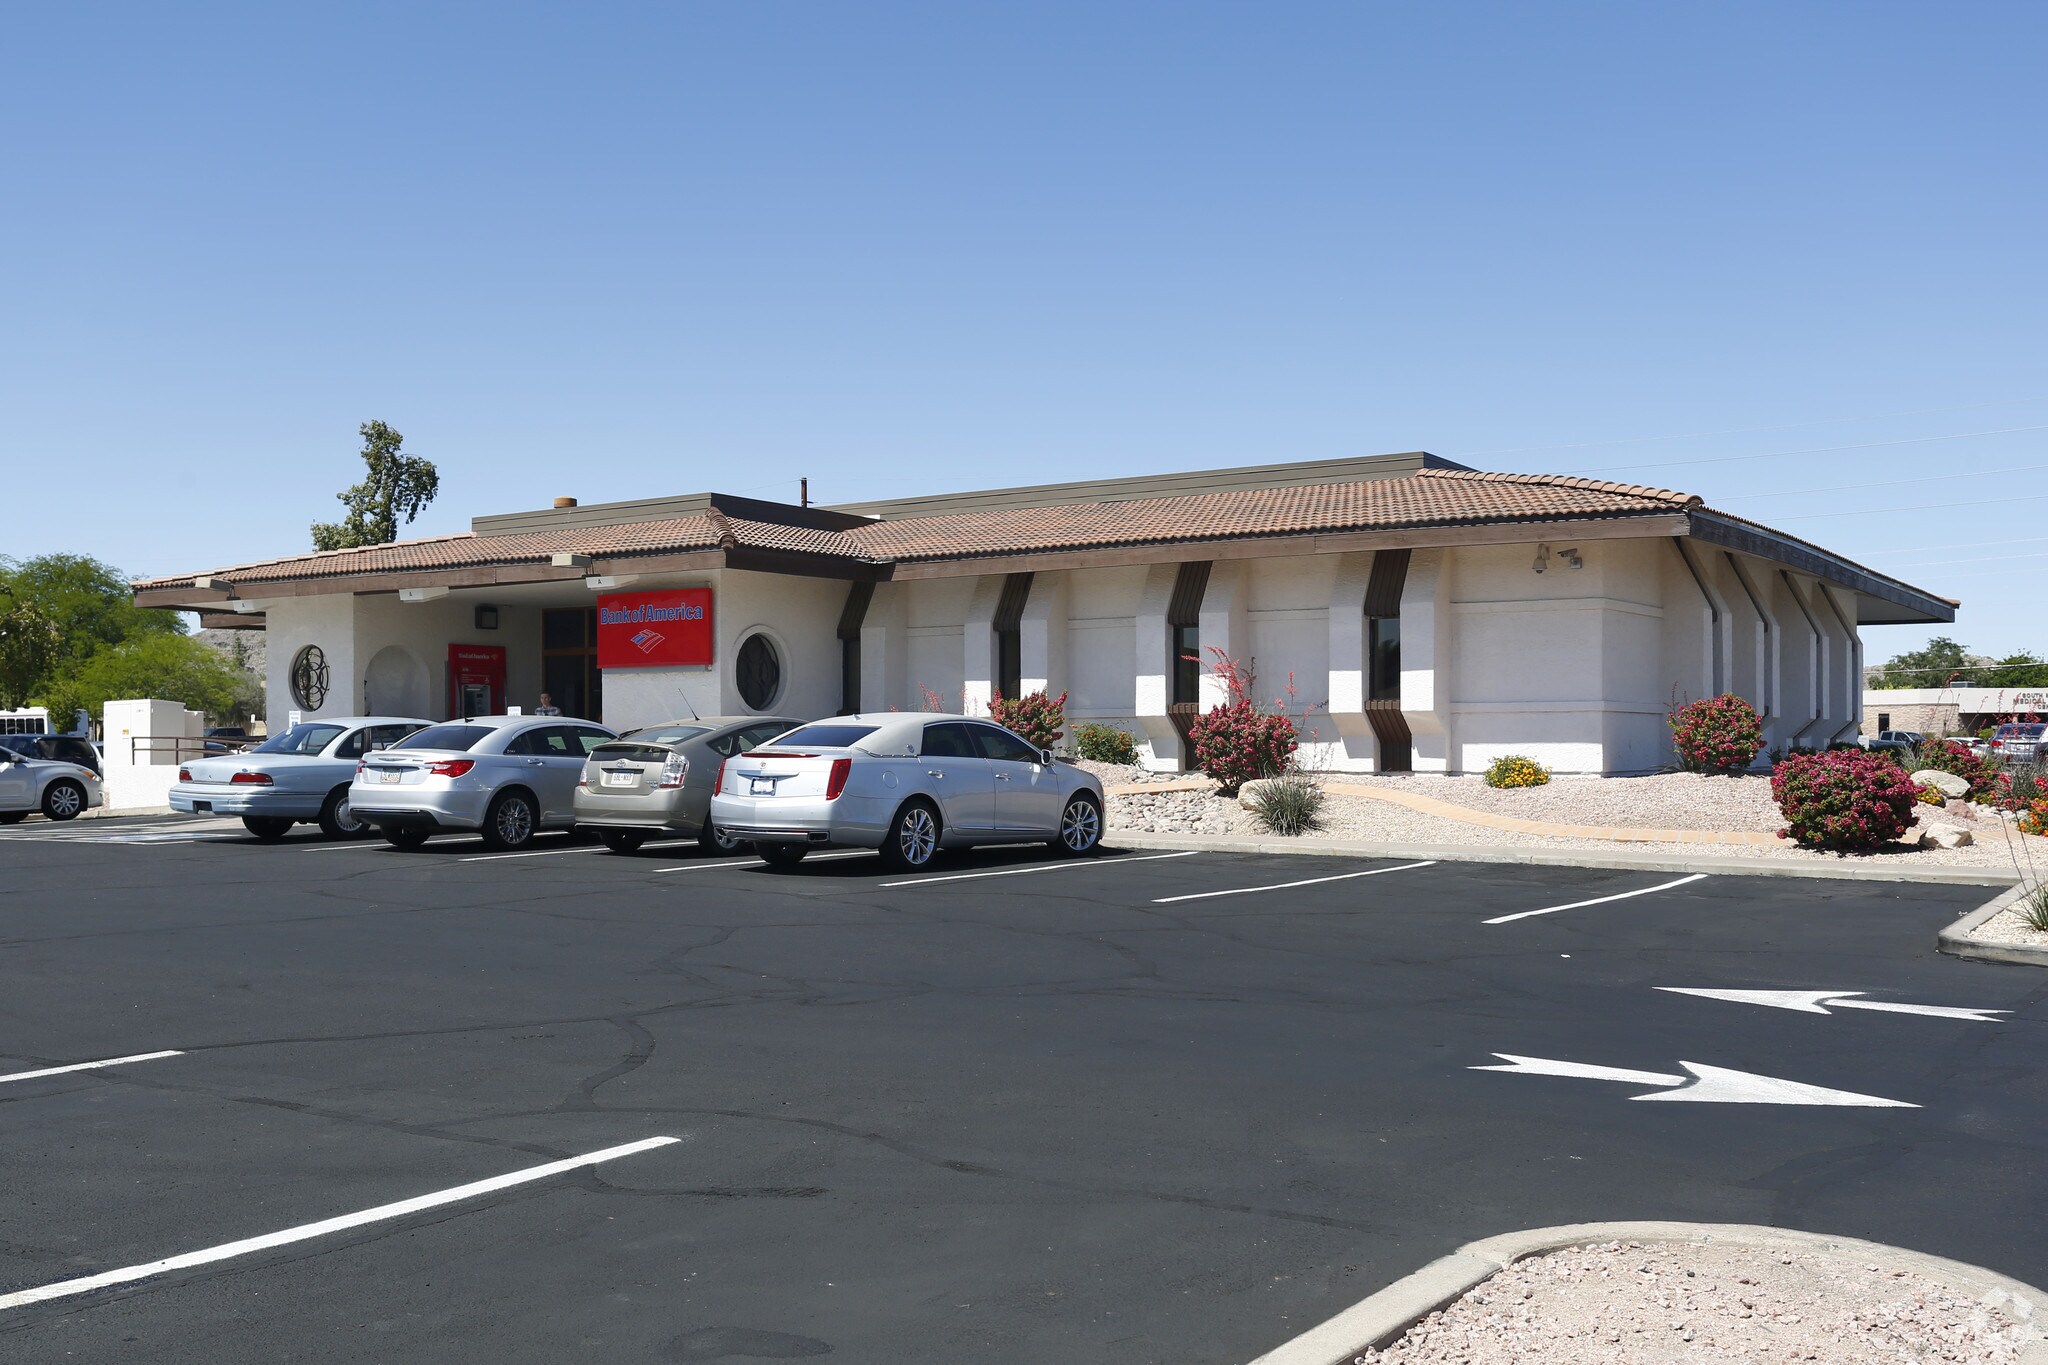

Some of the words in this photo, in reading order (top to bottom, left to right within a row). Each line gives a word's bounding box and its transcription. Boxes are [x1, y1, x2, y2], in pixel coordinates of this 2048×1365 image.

[601, 607, 631, 625] Bank
[631, 604, 645, 622] of
[646, 603, 703, 621] America
